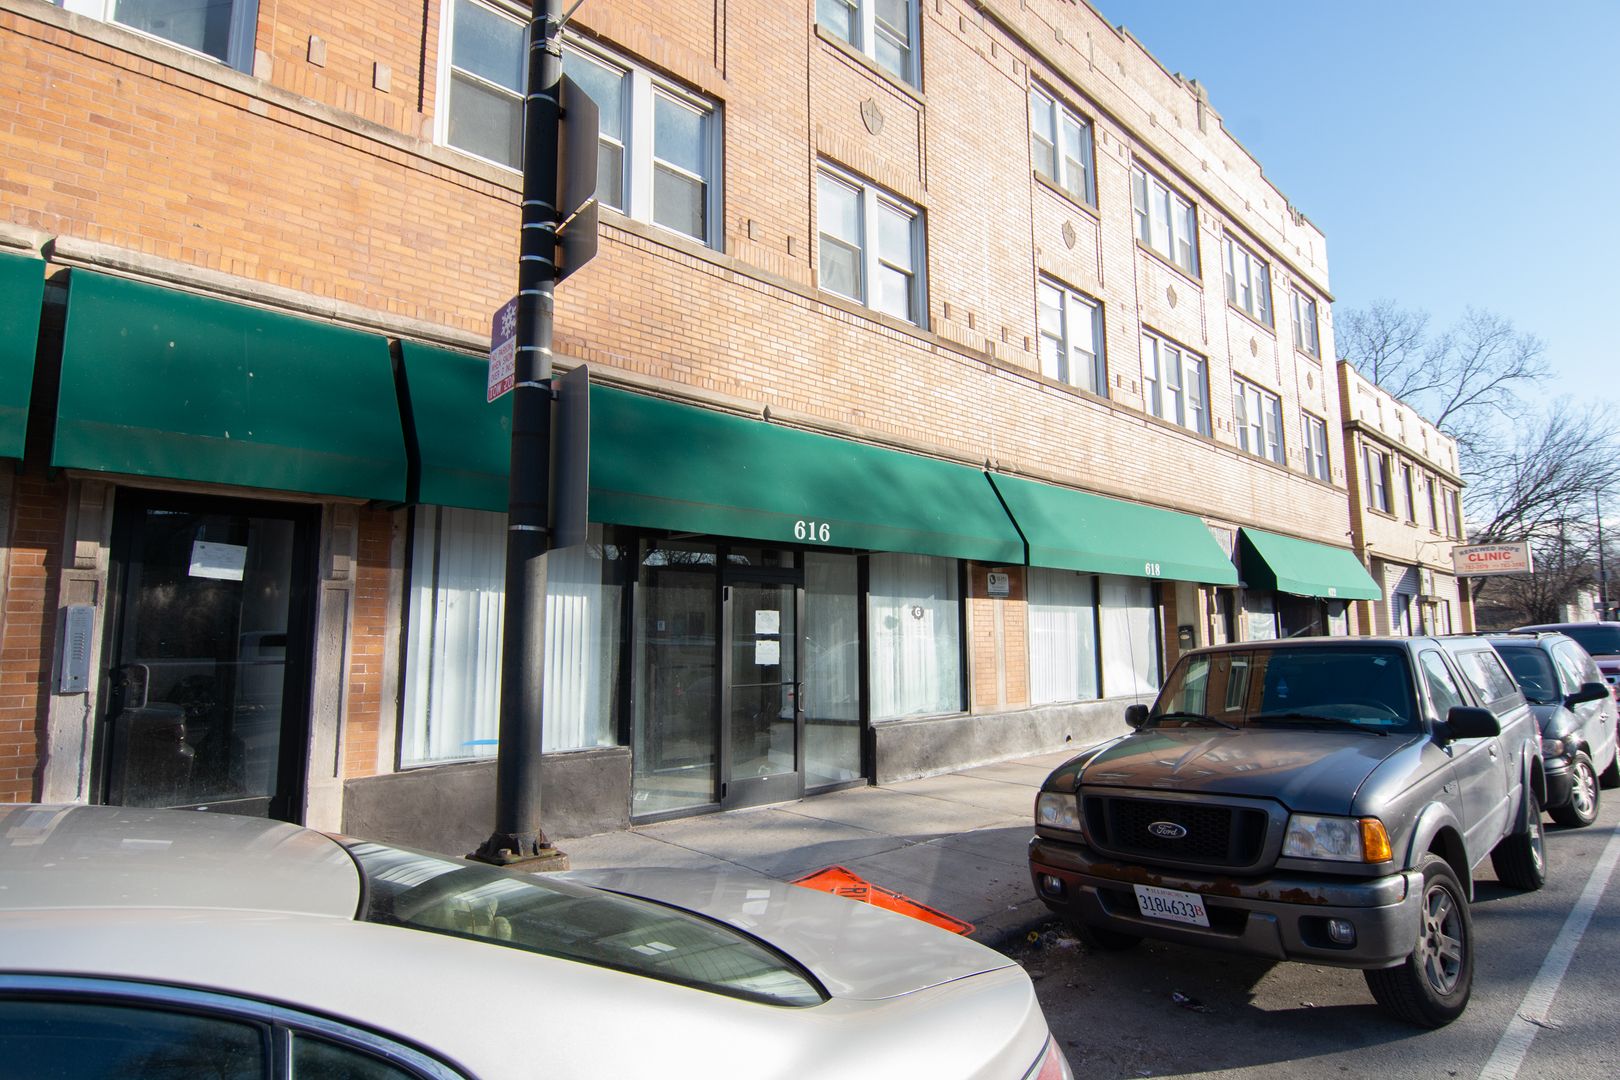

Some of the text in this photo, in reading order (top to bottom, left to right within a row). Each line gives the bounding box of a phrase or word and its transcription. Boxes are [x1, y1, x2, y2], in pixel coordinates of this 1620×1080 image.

[490, 383, 502, 399] TOW
[794, 520, 830, 542] 616
[1459, 546, 1496, 555] RENEWED
[1468, 552, 1511, 561] CLINIC
[1145, 562, 1161, 576] 618
[1156, 824, 1177, 835] Ford
